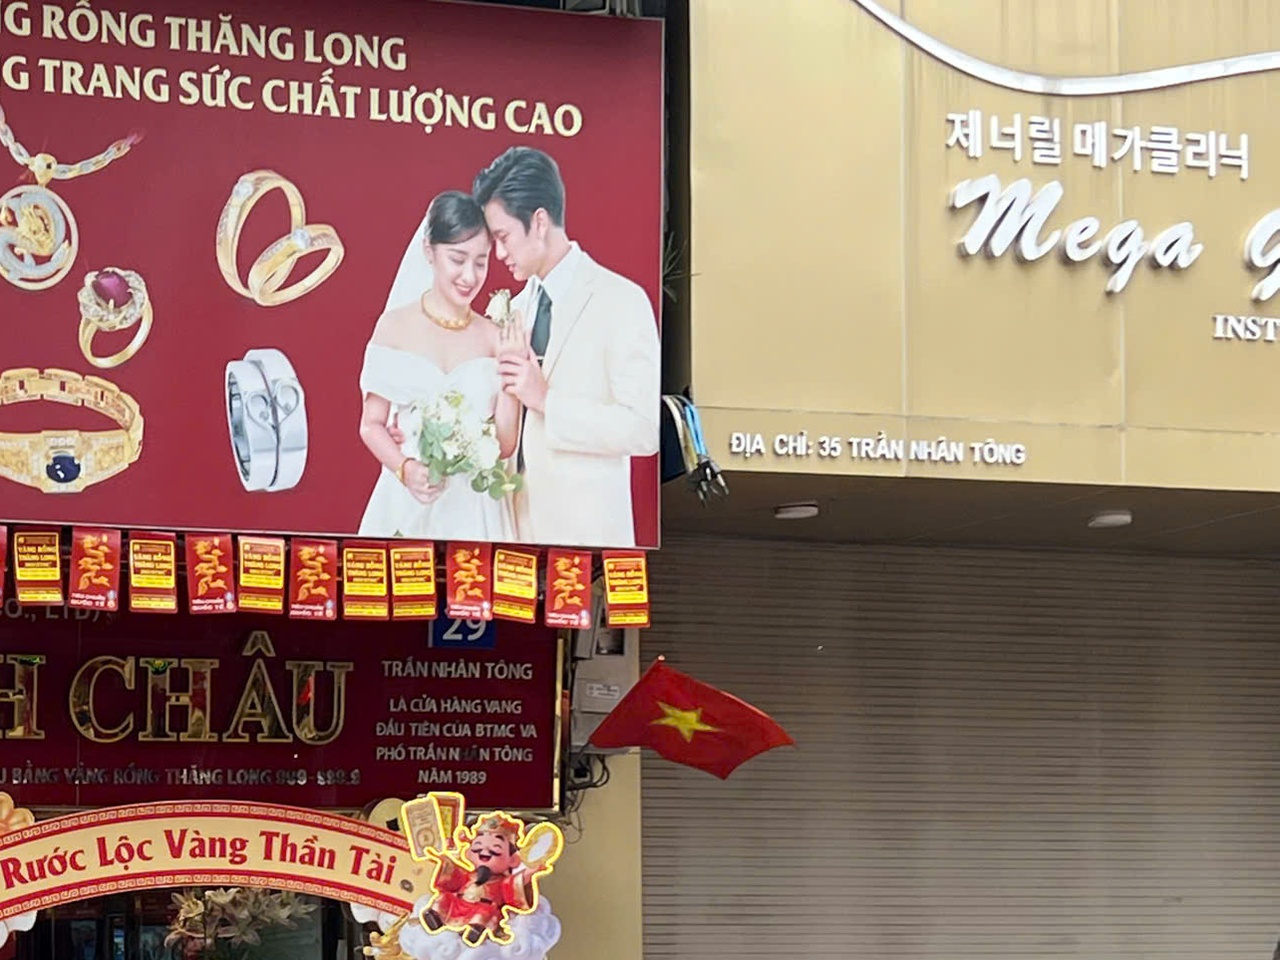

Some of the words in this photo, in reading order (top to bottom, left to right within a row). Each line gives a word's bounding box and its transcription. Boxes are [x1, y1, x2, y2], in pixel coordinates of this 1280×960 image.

[164, 14, 294, 62] THĂNG
[304, 29, 407, 71] LONG
[38, 58, 170, 103] TRANG
[178, 64, 254, 110] SỨC
[262, 68, 361, 119] CHẤT
[370, 85, 496, 134] LƯỢNG
[504, 100, 583, 137] CAO
[946, 109, 1062, 165] 제너릴
[1073, 121, 1249, 181] 메가클리닉
[950, 173, 1205, 294] Mega
[730, 432, 765, 458] ĐỊA
[819, 436, 842, 457] 35
[969, 440, 1026, 465] TÔNG
[442, 618, 487, 641] 29
[68, 630, 355, 745] CHÂU
[484, 659, 533, 680] TÔNG
[475, 723, 515, 738] BTMC
[494, 744, 533, 762] TÔNG
[418, 767, 452, 784] NĂM
[455, 771, 487, 784] 1989
[0, 844, 87, 891] Rước
[95, 835, 153, 872] Lộc
[163, 827, 249, 865] Vàng
[258, 830, 338, 870] Thần
[348, 845, 398, 886] Tài
